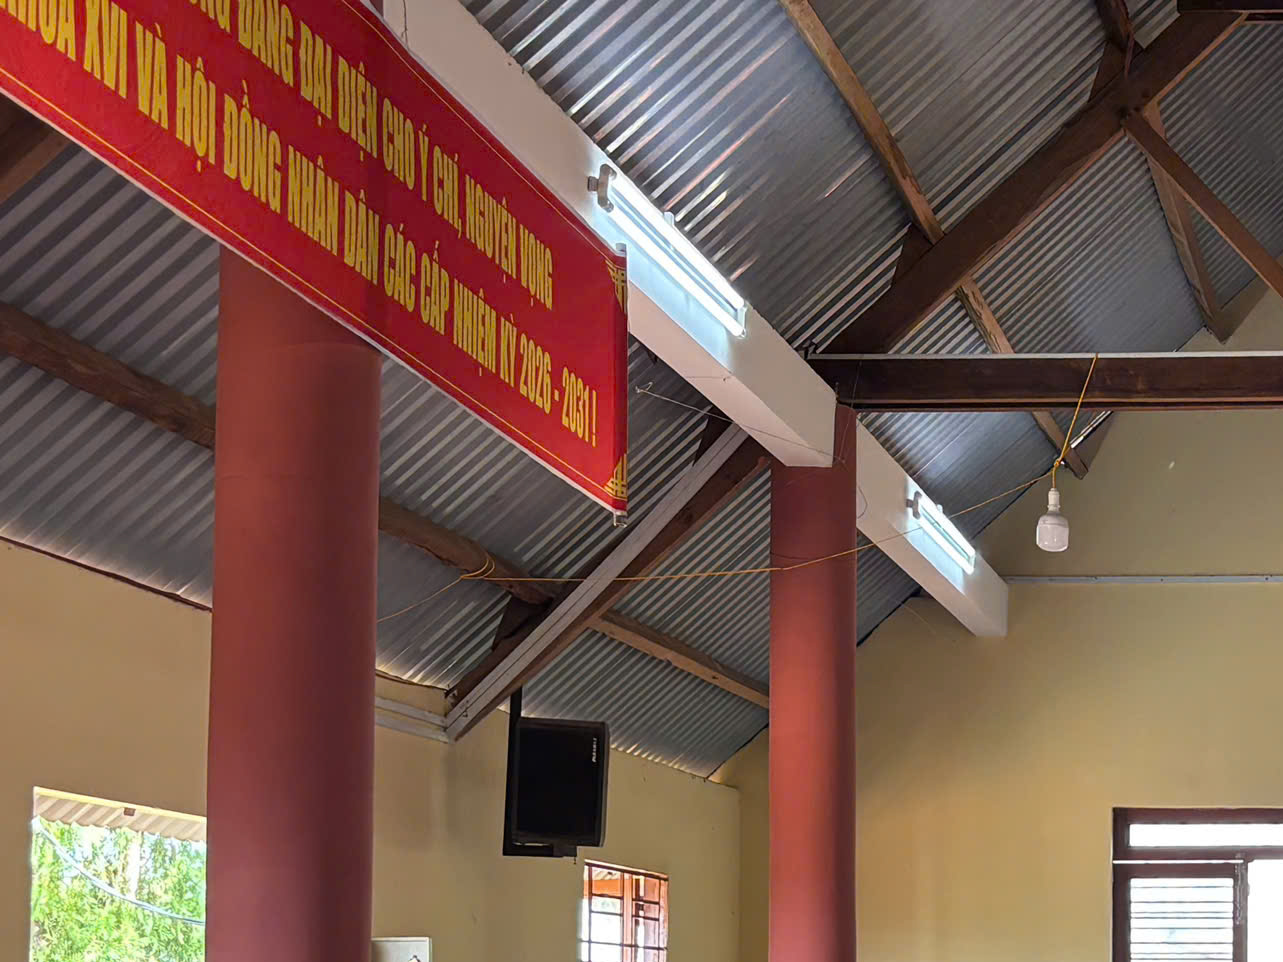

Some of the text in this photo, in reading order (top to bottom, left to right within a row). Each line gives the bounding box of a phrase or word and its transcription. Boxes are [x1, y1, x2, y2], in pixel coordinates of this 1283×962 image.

[83, 0, 128, 99] XVI
[136, 22, 169, 131] VÀ
[175, 54, 217, 173] HỘI
[223, 79, 283, 215] ĐỒNG
[287, 143, 340, 256] NHÂN
[343, 188, 380, 286] DÂN
[383, 223, 417, 313] CÁC
[420, 239, 450, 335] CẤP
[453, 277, 497, 377] NHIỆM
[500, 313, 518, 388] KỲ
[520, 332, 552, 415] 2026
[299, 20, 333, 127] ĐẠI
[338, 55, 379, 162] DIỆN
[382, 97, 416, 191] CHO
[419, 124, 429, 201] Ý
[465, 174, 517, 283] NGUYỆN
[520, 224, 553, 311] VỌNG
